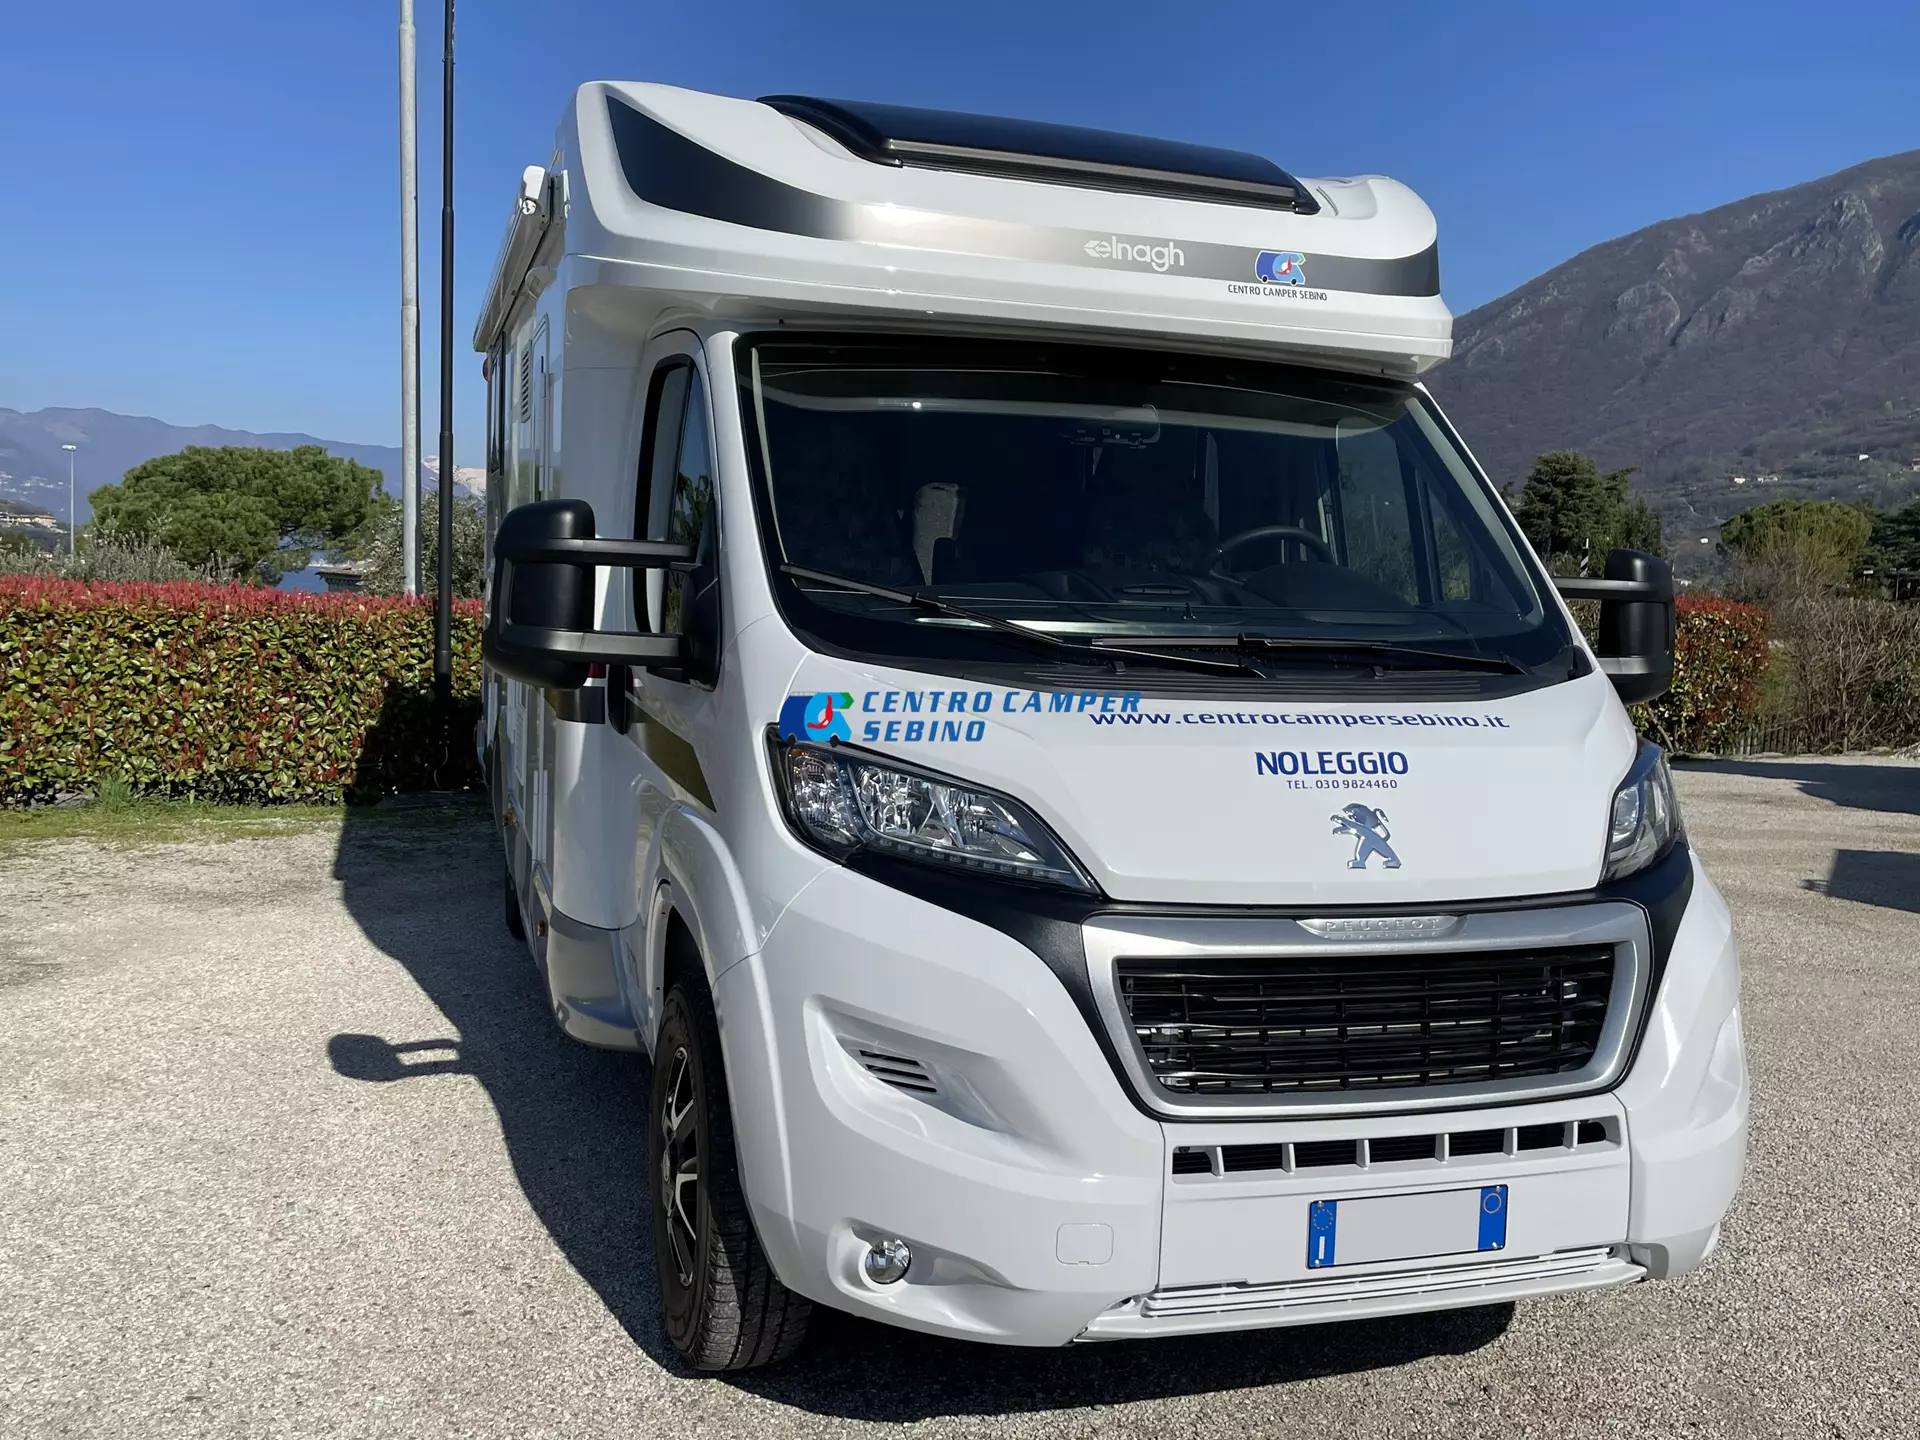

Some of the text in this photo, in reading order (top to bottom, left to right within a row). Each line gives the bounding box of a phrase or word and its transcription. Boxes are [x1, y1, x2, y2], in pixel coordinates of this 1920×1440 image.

[1093, 236, 1185, 272] elnagh
[1227, 284, 1328, 301] CENTRO CAMPER SEBINO
[1088, 712, 1510, 728] www.centrocampersebino.it
[1255, 751, 1409, 776] NOLEGGIO
[1287, 779, 1398, 789] TEL. 030 9824460
[1325, 918, 1439, 931] PEUGEOT
